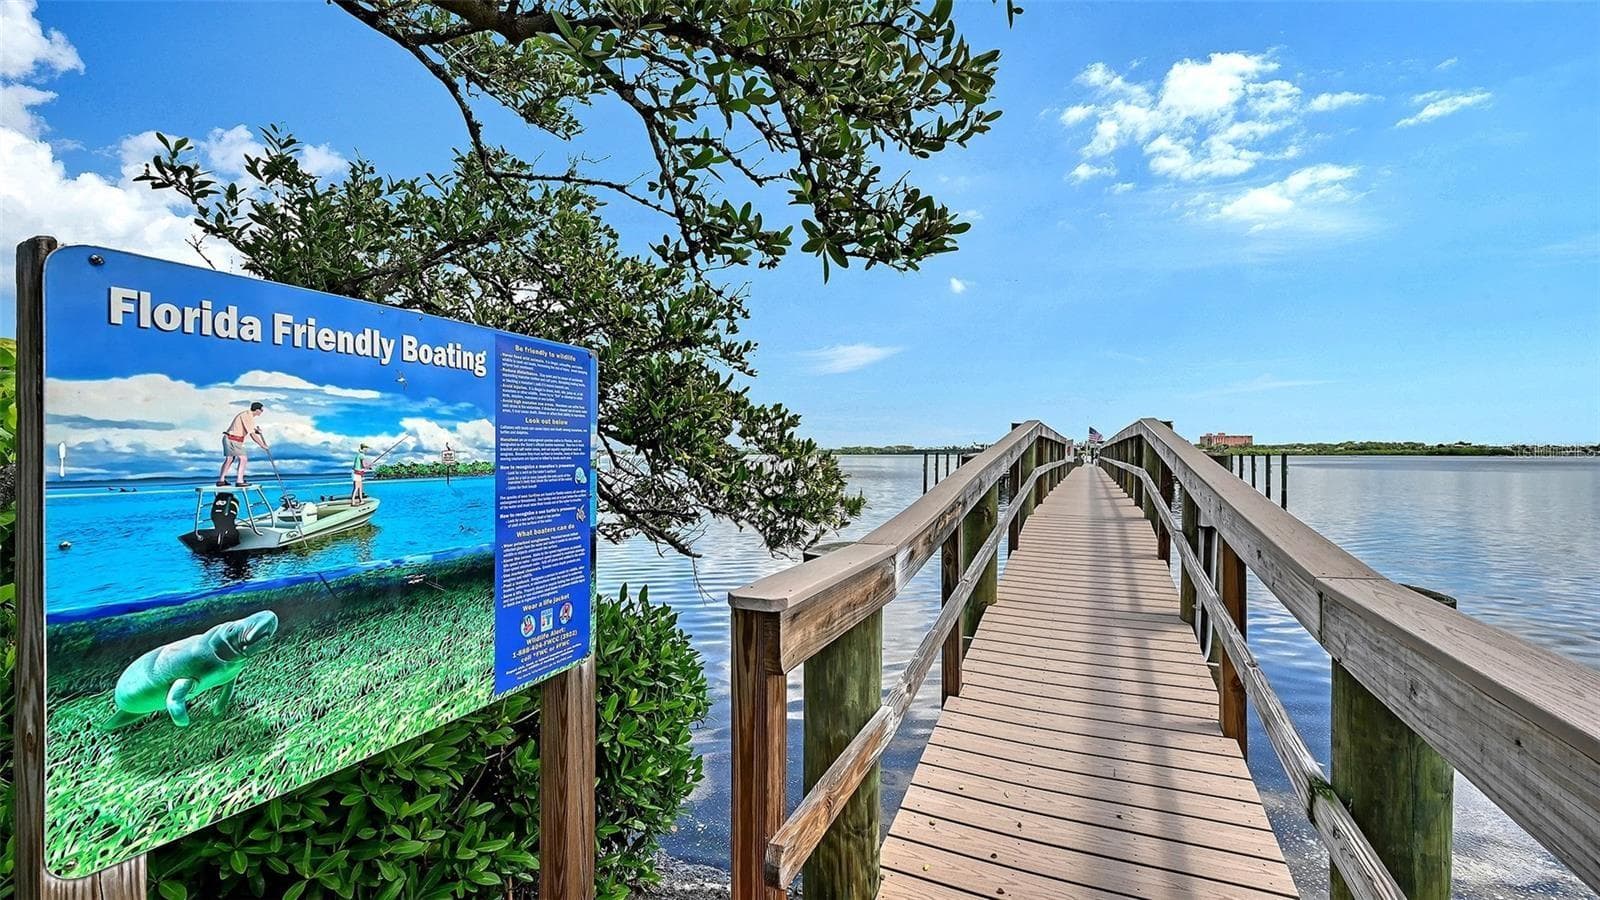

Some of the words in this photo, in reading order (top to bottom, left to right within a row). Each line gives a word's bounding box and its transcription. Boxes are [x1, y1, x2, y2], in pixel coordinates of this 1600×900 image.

[109, 286, 262, 343] Florida
[273, 312, 396, 366] Friendly
[401, 334, 488, 378] Boating
[515, 344, 524, 352] Be
[525, 346, 547, 357] friendly
[556, 352, 577, 362] wildlife
[525, 417, 540, 425] Look
[533, 527, 556, 535] boaters
[522, 603, 538, 612] Wear
[553, 593, 570, 604] jacket
[526, 633, 550, 646] Wildlife
